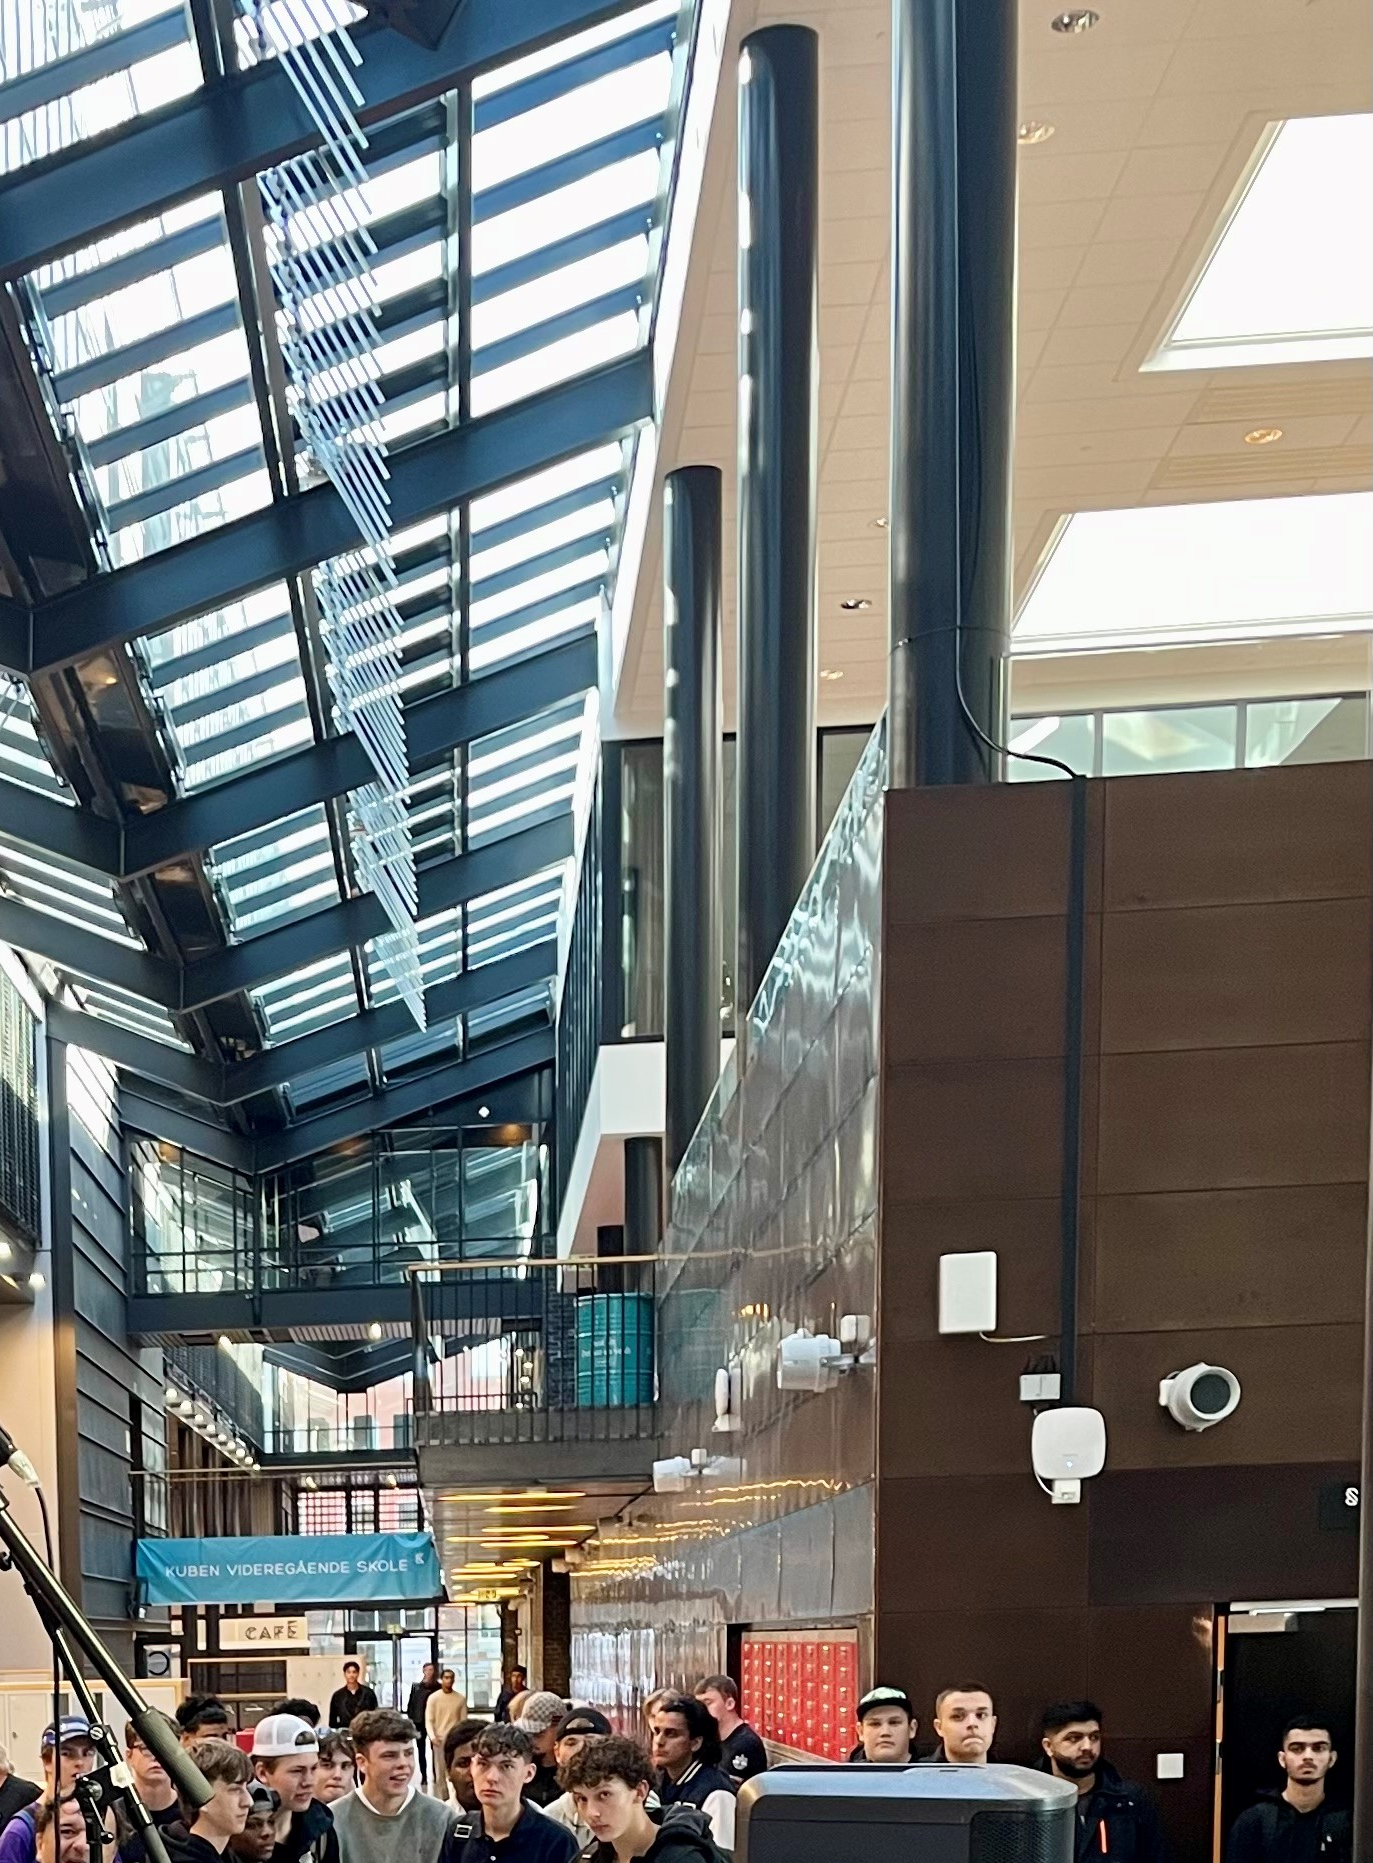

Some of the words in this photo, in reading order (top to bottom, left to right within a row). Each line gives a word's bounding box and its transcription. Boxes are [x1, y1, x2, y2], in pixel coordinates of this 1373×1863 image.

[165, 1564, 220, 1578] KUBEN
[226, 1560, 350, 1577] VIDEREGÅENDE
[356, 1558, 408, 1574] SKOLE
